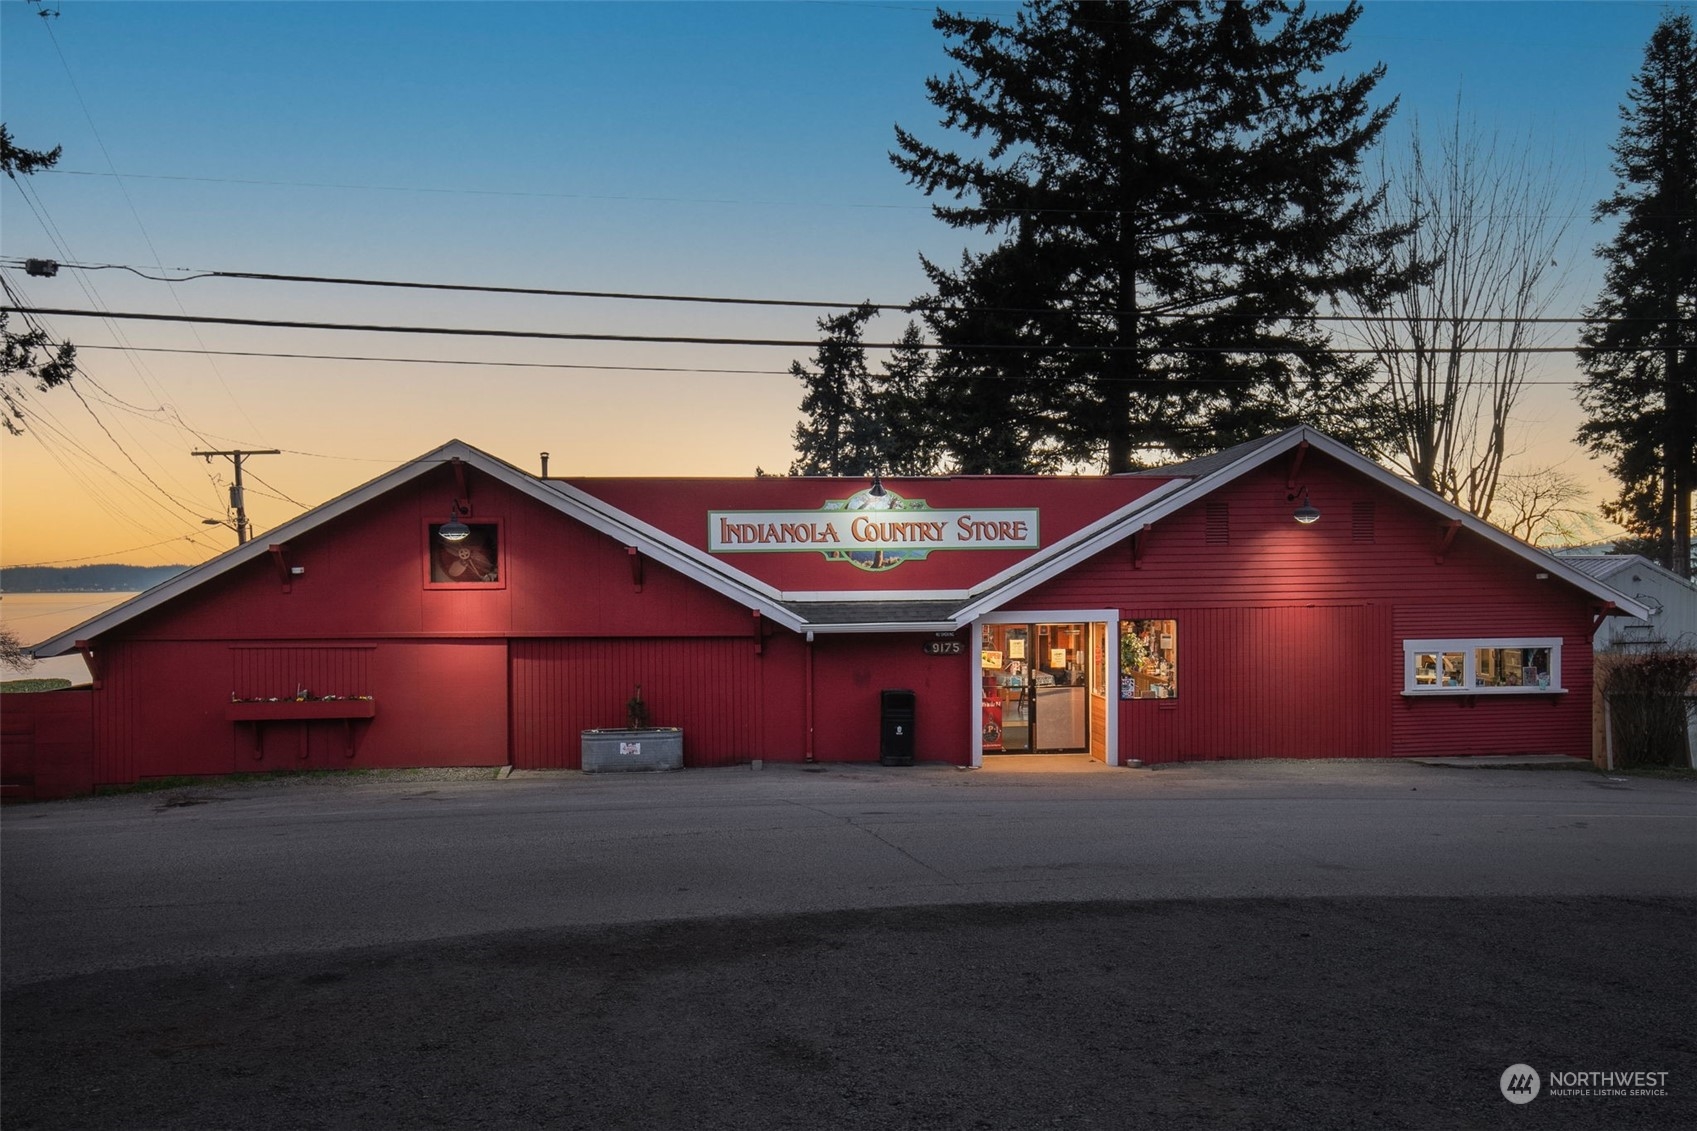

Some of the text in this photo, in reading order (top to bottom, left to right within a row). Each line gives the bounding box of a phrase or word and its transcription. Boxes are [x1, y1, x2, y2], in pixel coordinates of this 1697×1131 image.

[720, 515, 1028, 544] INDIANOLA COUNTRY STORE
[932, 642, 960, 653] 9175
